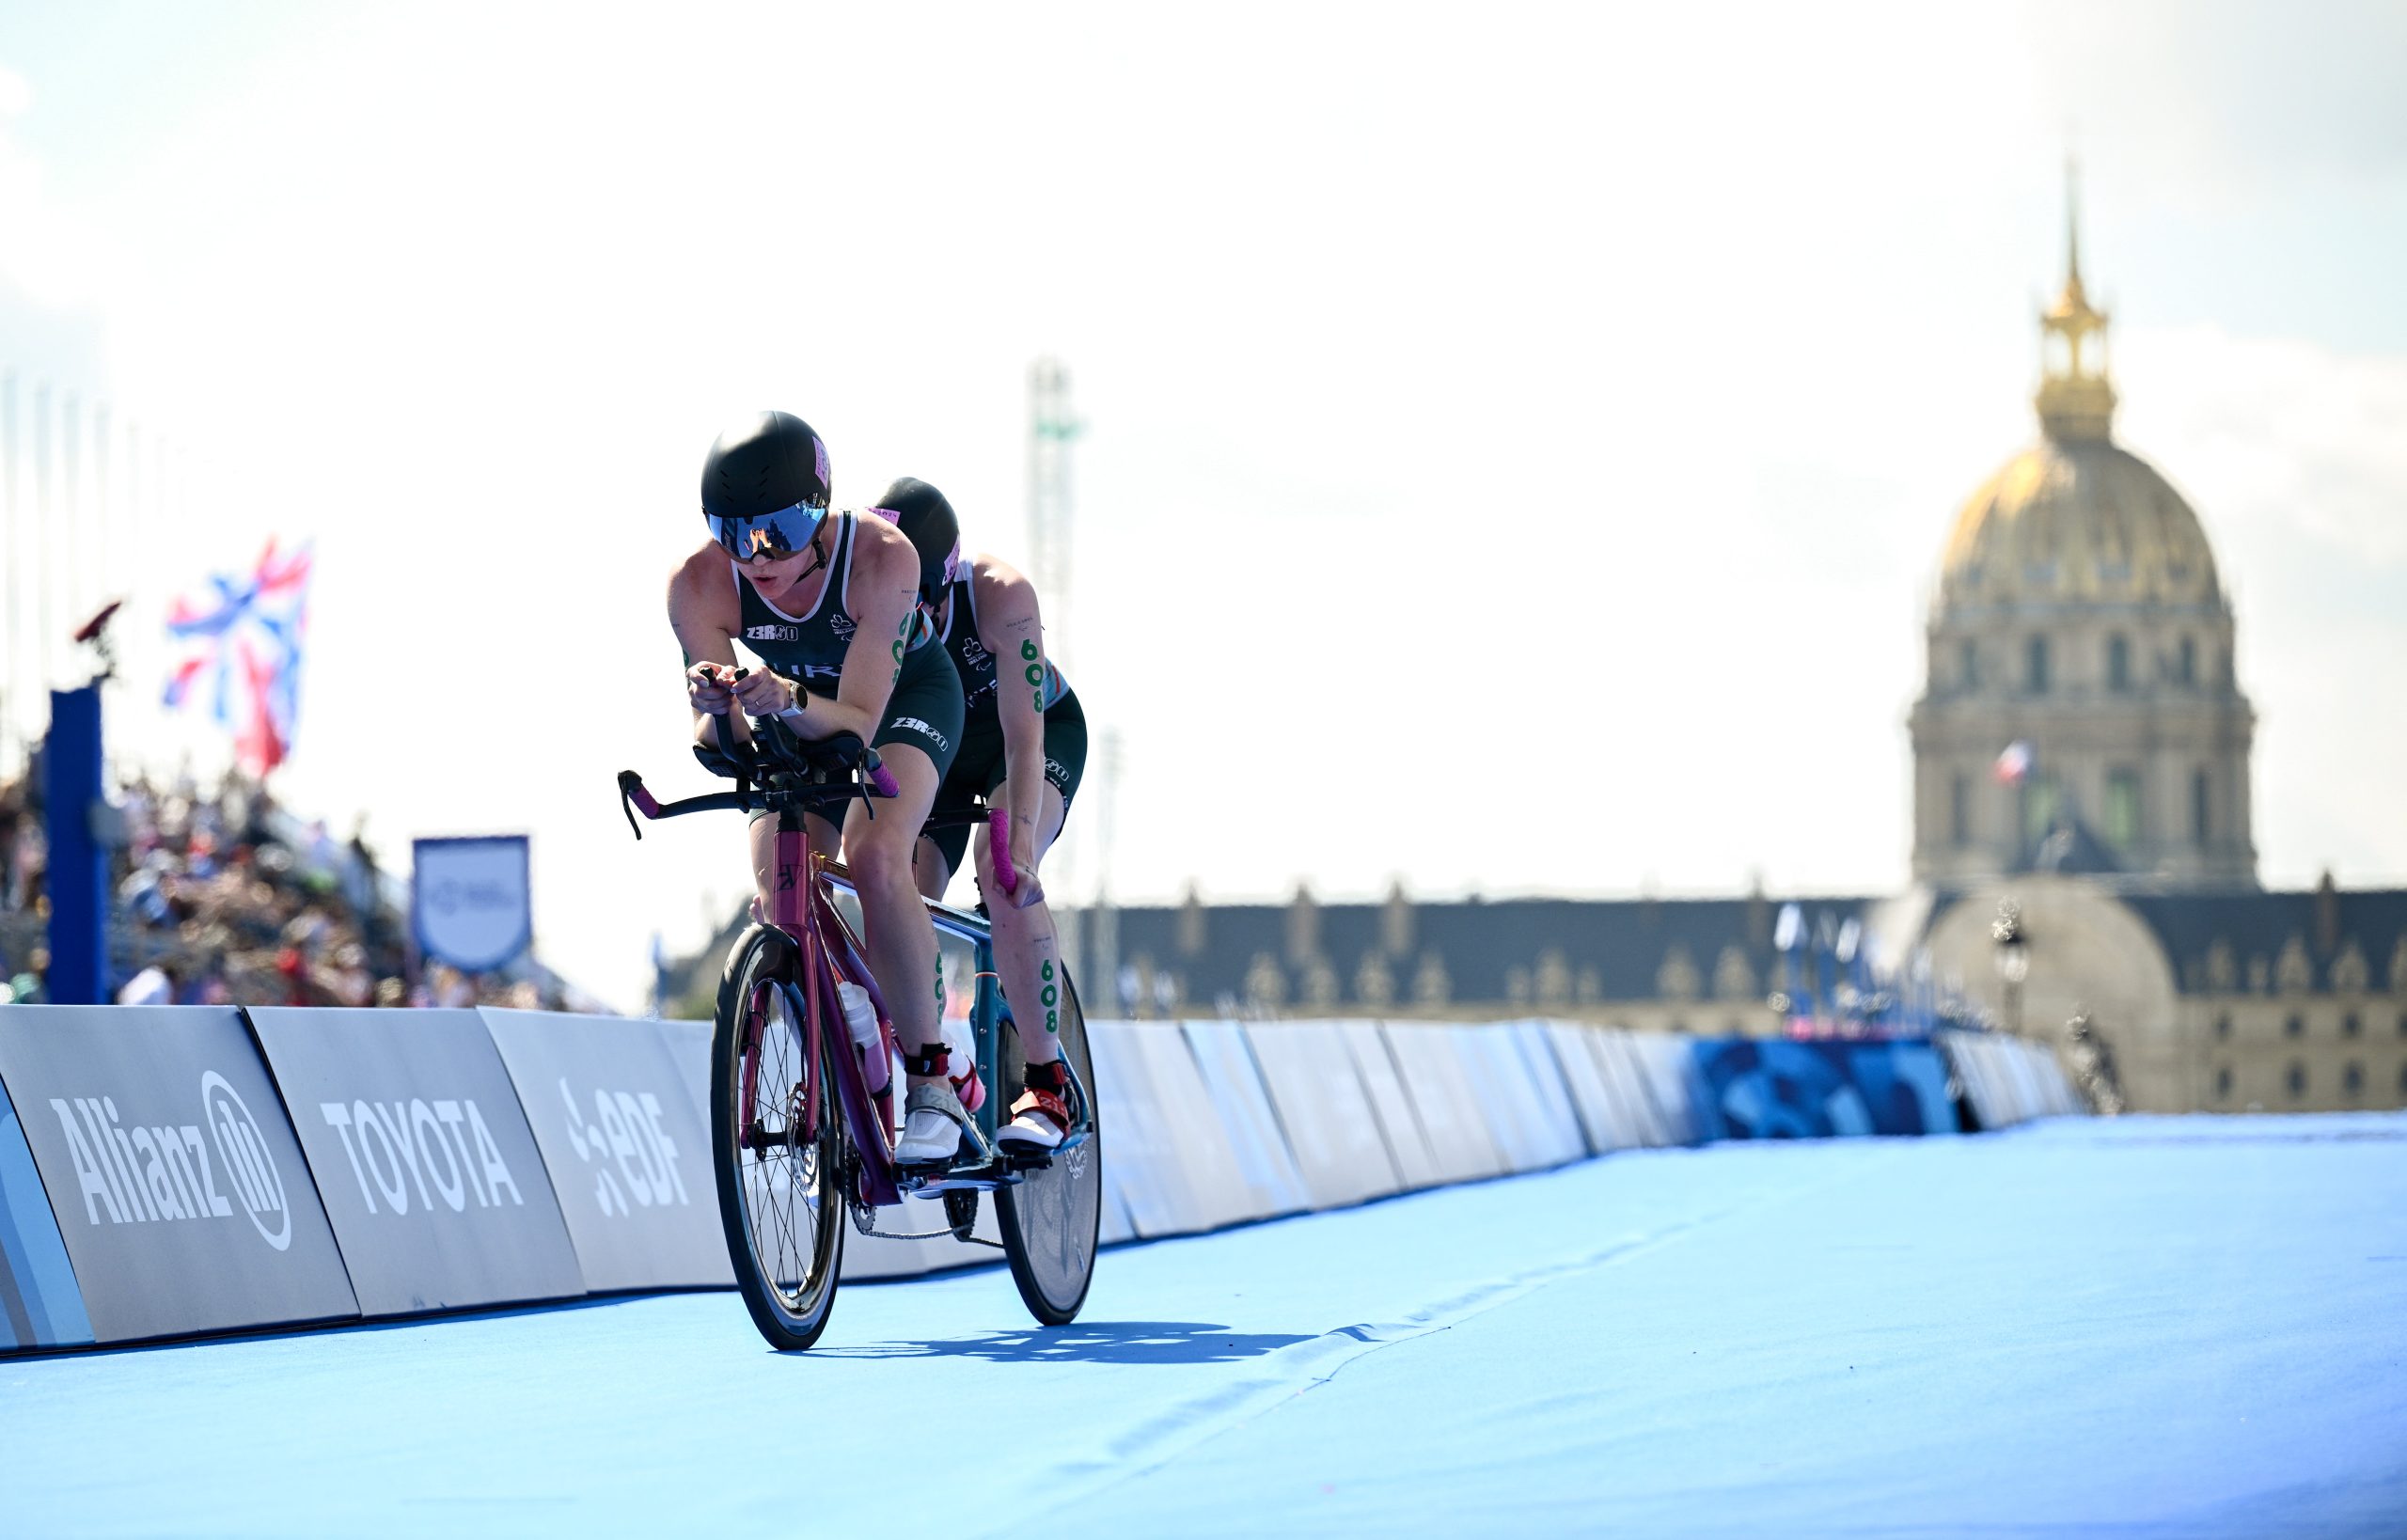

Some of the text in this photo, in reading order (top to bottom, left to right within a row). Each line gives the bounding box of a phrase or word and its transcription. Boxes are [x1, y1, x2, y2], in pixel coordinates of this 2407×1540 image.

[1021, 638, 1044, 713] 608
[1040, 959, 1058, 1033] 608
[48, 1095, 234, 1225] Allianz
[320, 1097, 525, 1216] TOYOTA
